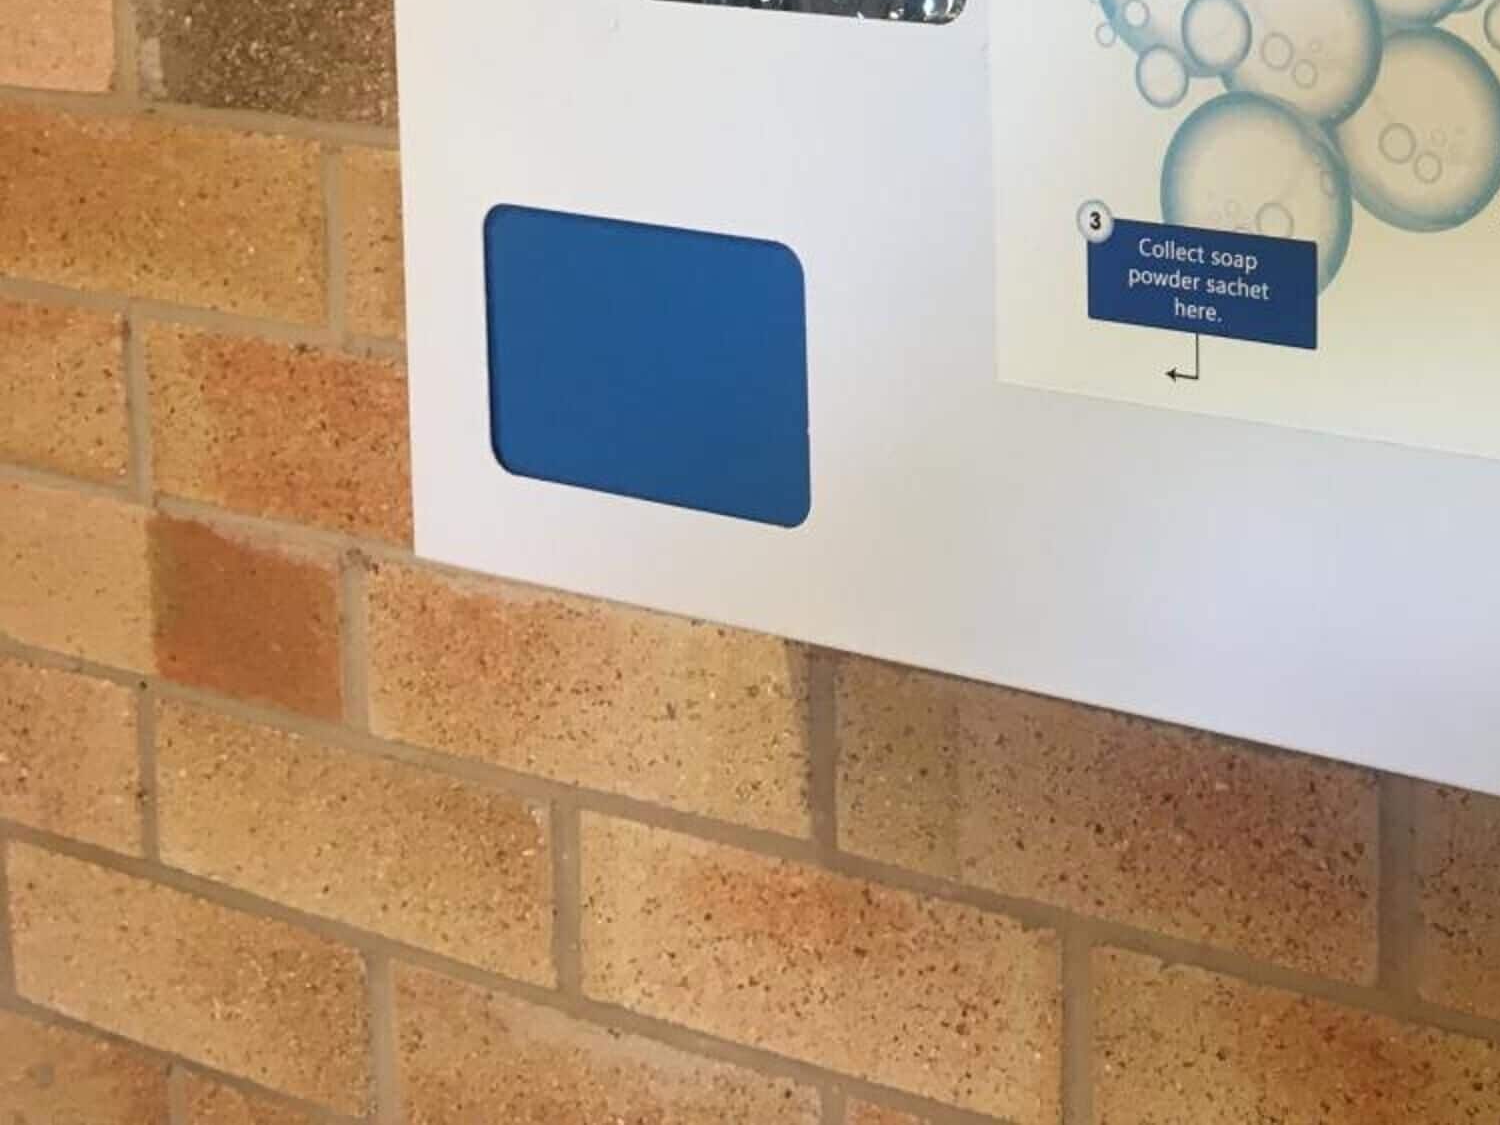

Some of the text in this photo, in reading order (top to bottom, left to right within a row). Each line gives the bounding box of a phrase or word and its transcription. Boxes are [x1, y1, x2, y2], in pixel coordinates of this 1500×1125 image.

[1089, 212, 1101, 230] 3
[1139, 238, 1258, 273] Collect soap
[1128, 269, 1270, 301] powder sachet
[1175, 298, 1223, 323] here.
